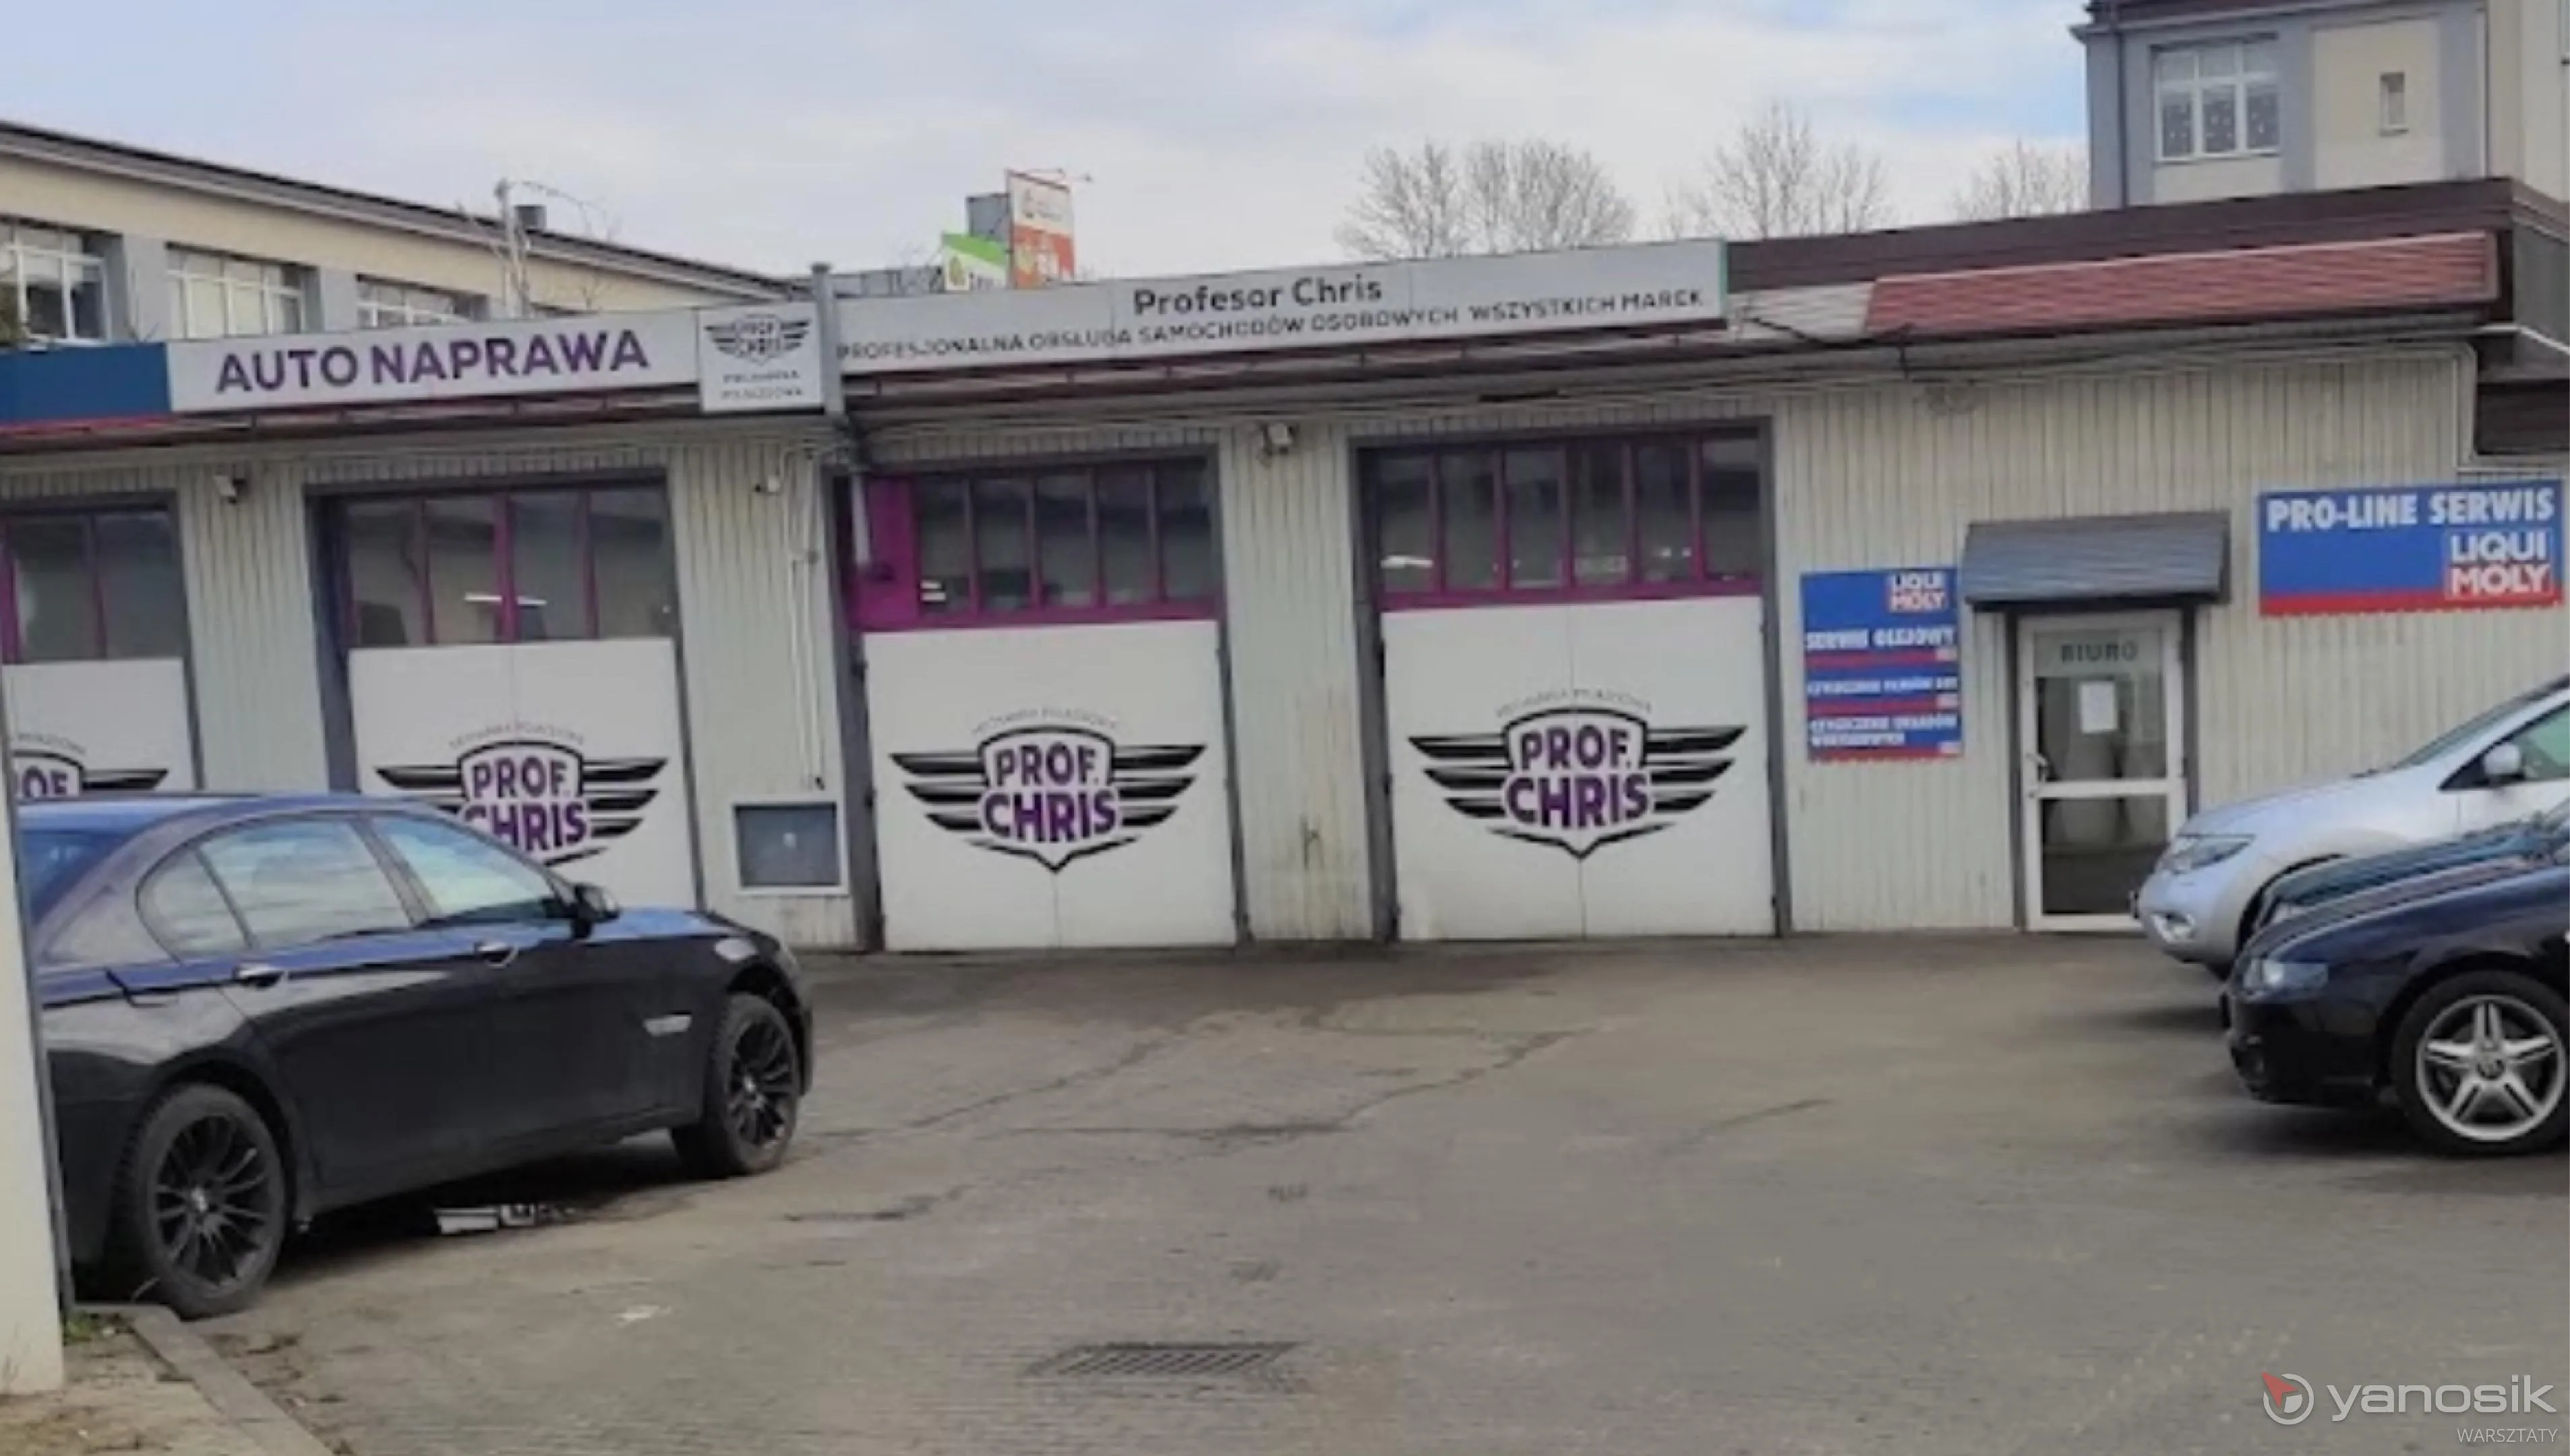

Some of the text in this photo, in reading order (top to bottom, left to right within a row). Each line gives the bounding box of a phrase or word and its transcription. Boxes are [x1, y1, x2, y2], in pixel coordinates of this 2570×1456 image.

[1133, 273, 1383, 315] Profesor Chris
[1311, 307, 1459, 333] OSOBOWYCH
[1468, 297, 1615, 322] WSZYSTKICH
[1620, 289, 1704, 311] MAREK
[215, 328, 649, 394] AUTO NAPRAWA
[2266, 487, 2555, 532] PRO-LINE SERWIS
[2451, 531, 2548, 562] LIQUI
[2451, 564, 2550, 597] MOLY
[2060, 641, 2139, 663] BIURO
[994, 742, 1100, 787] PROF.
[1520, 725, 1632, 770] PROF.
[984, 789, 1118, 843] CHRIS
[1506, 773, 1650, 828] CHRIS
